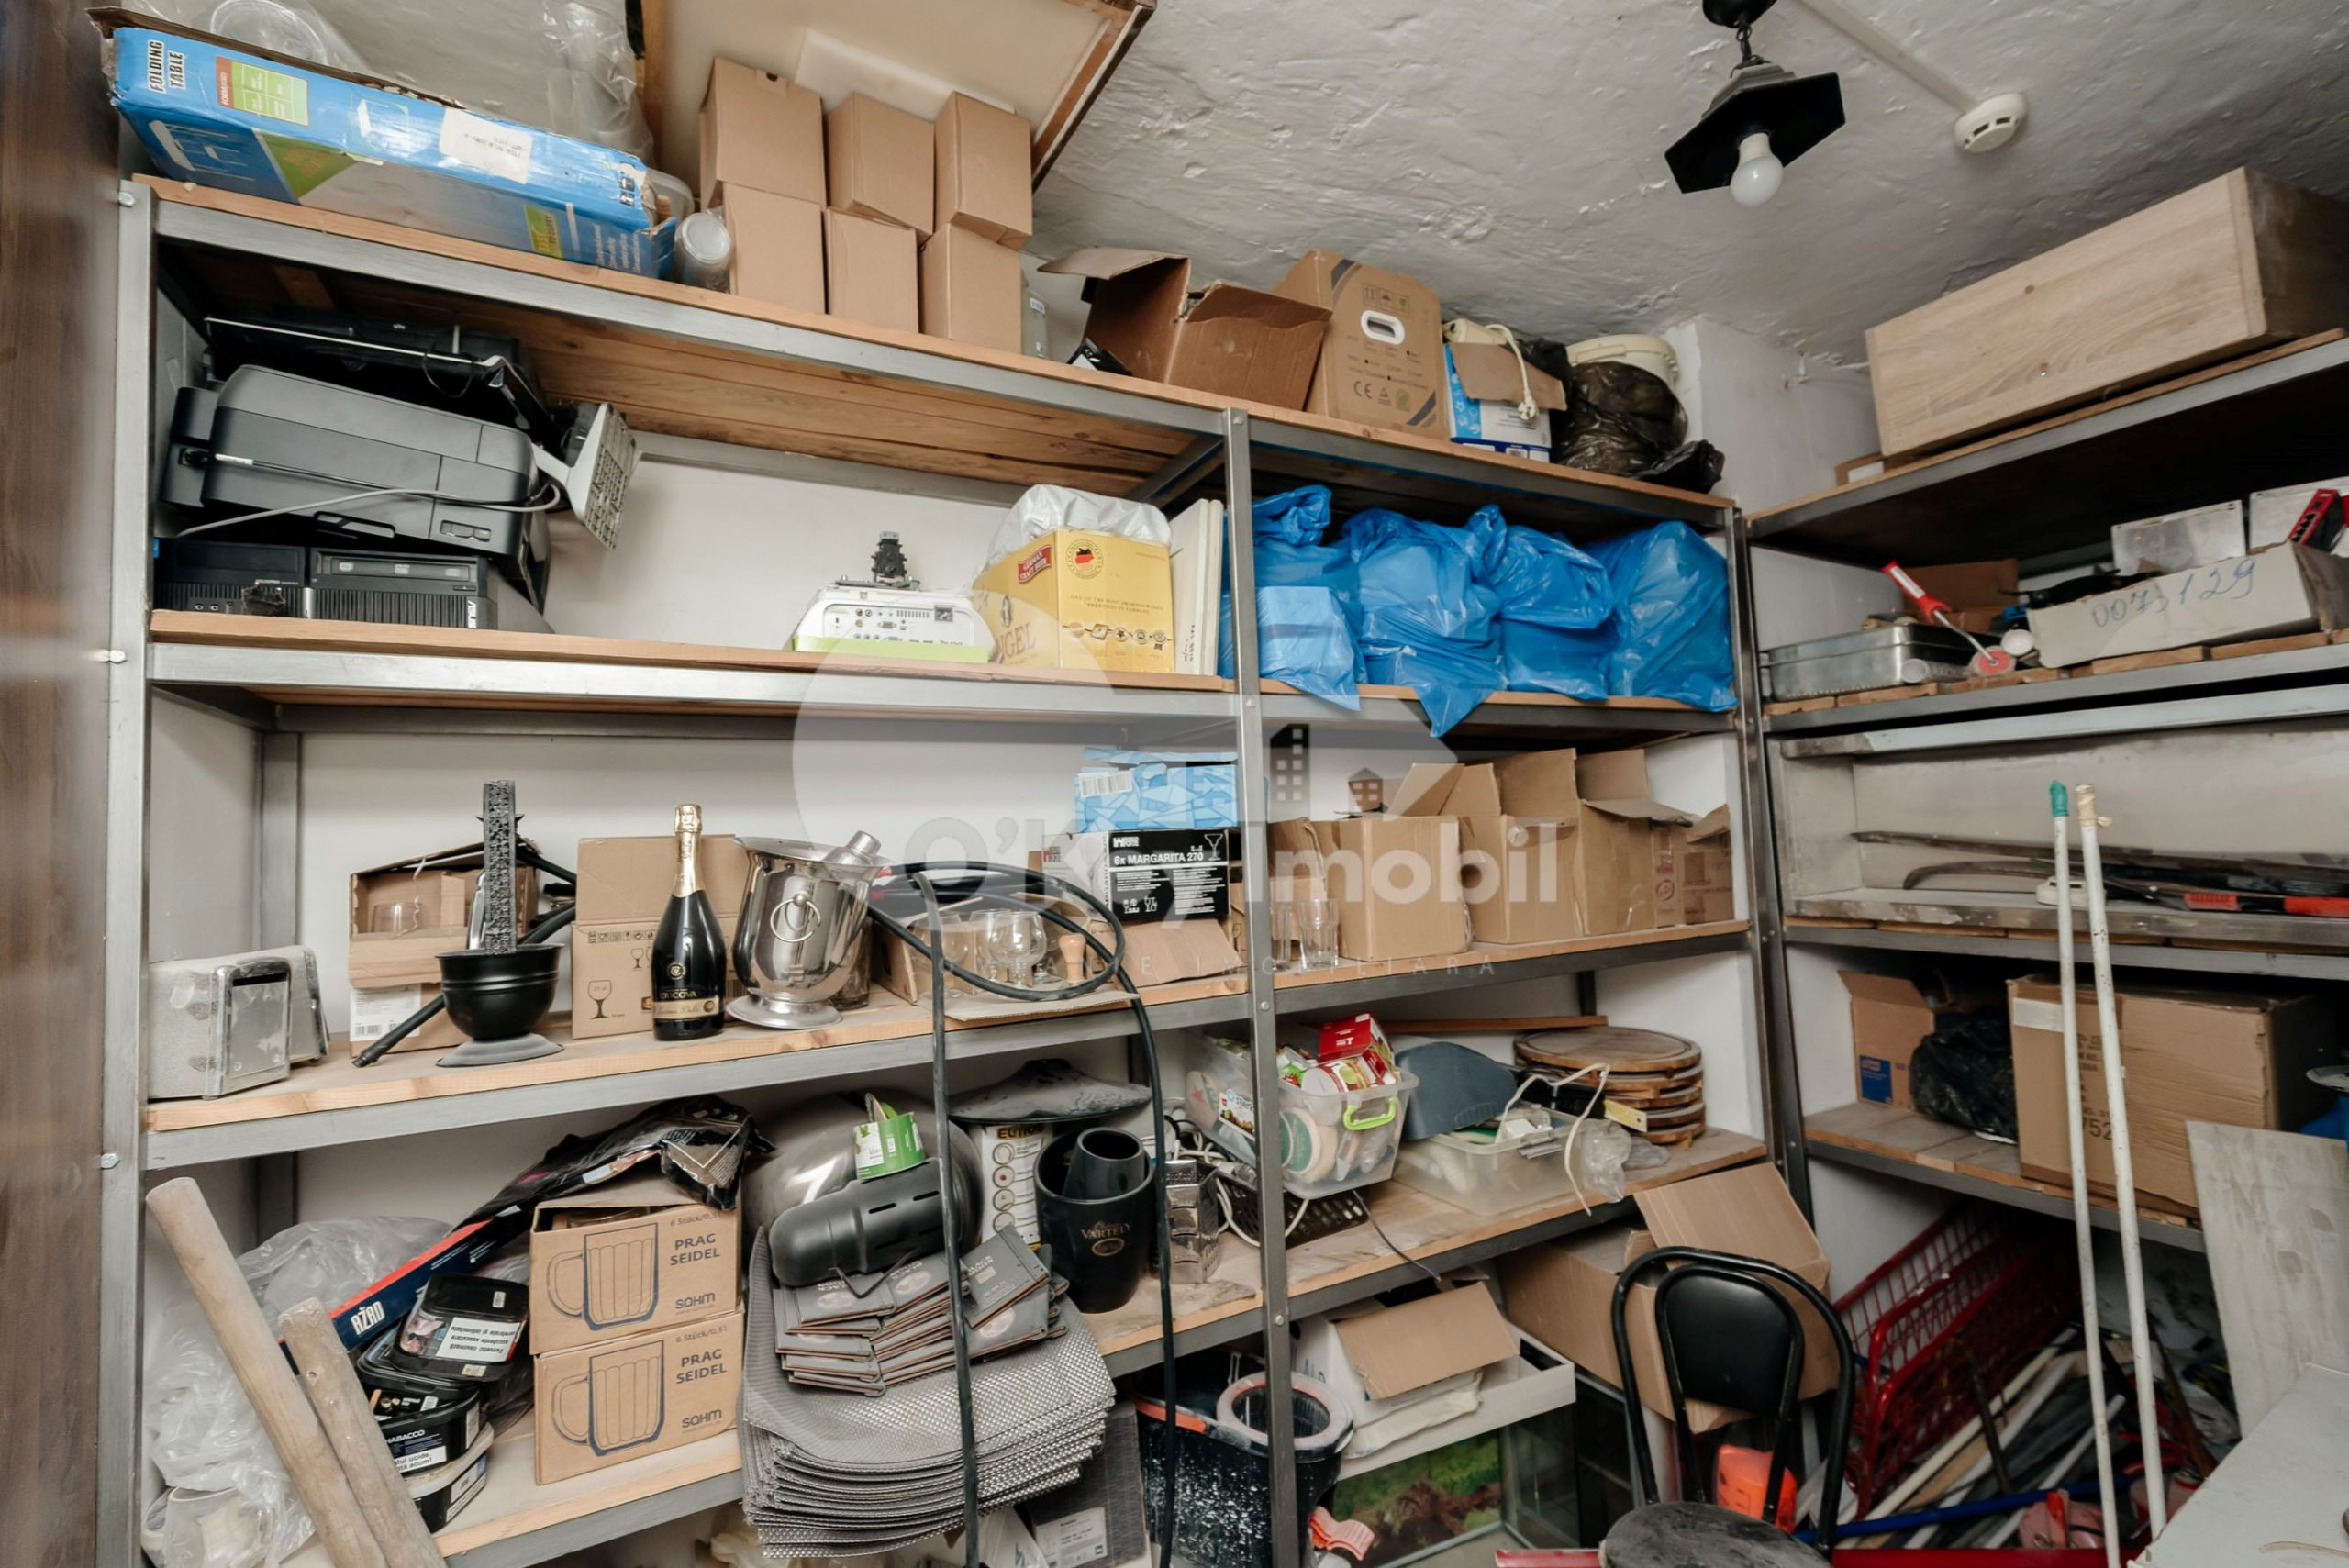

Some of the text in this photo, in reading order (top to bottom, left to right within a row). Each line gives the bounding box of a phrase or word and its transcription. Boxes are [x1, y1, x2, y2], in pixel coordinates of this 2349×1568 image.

[149, 40, 165, 93] FOLDING
[168, 51, 185, 89] TABLE
[1114, 852, 1204, 866] 6x MARGARITA 270
[660, 991, 697, 999] CRICOVA
[674, 1233, 716, 1250] PRAG
[670, 1248, 720, 1266] SEIDEL
[681, 1349, 722, 1367] PRAG
[676, 1363, 727, 1384] SEIDEL
